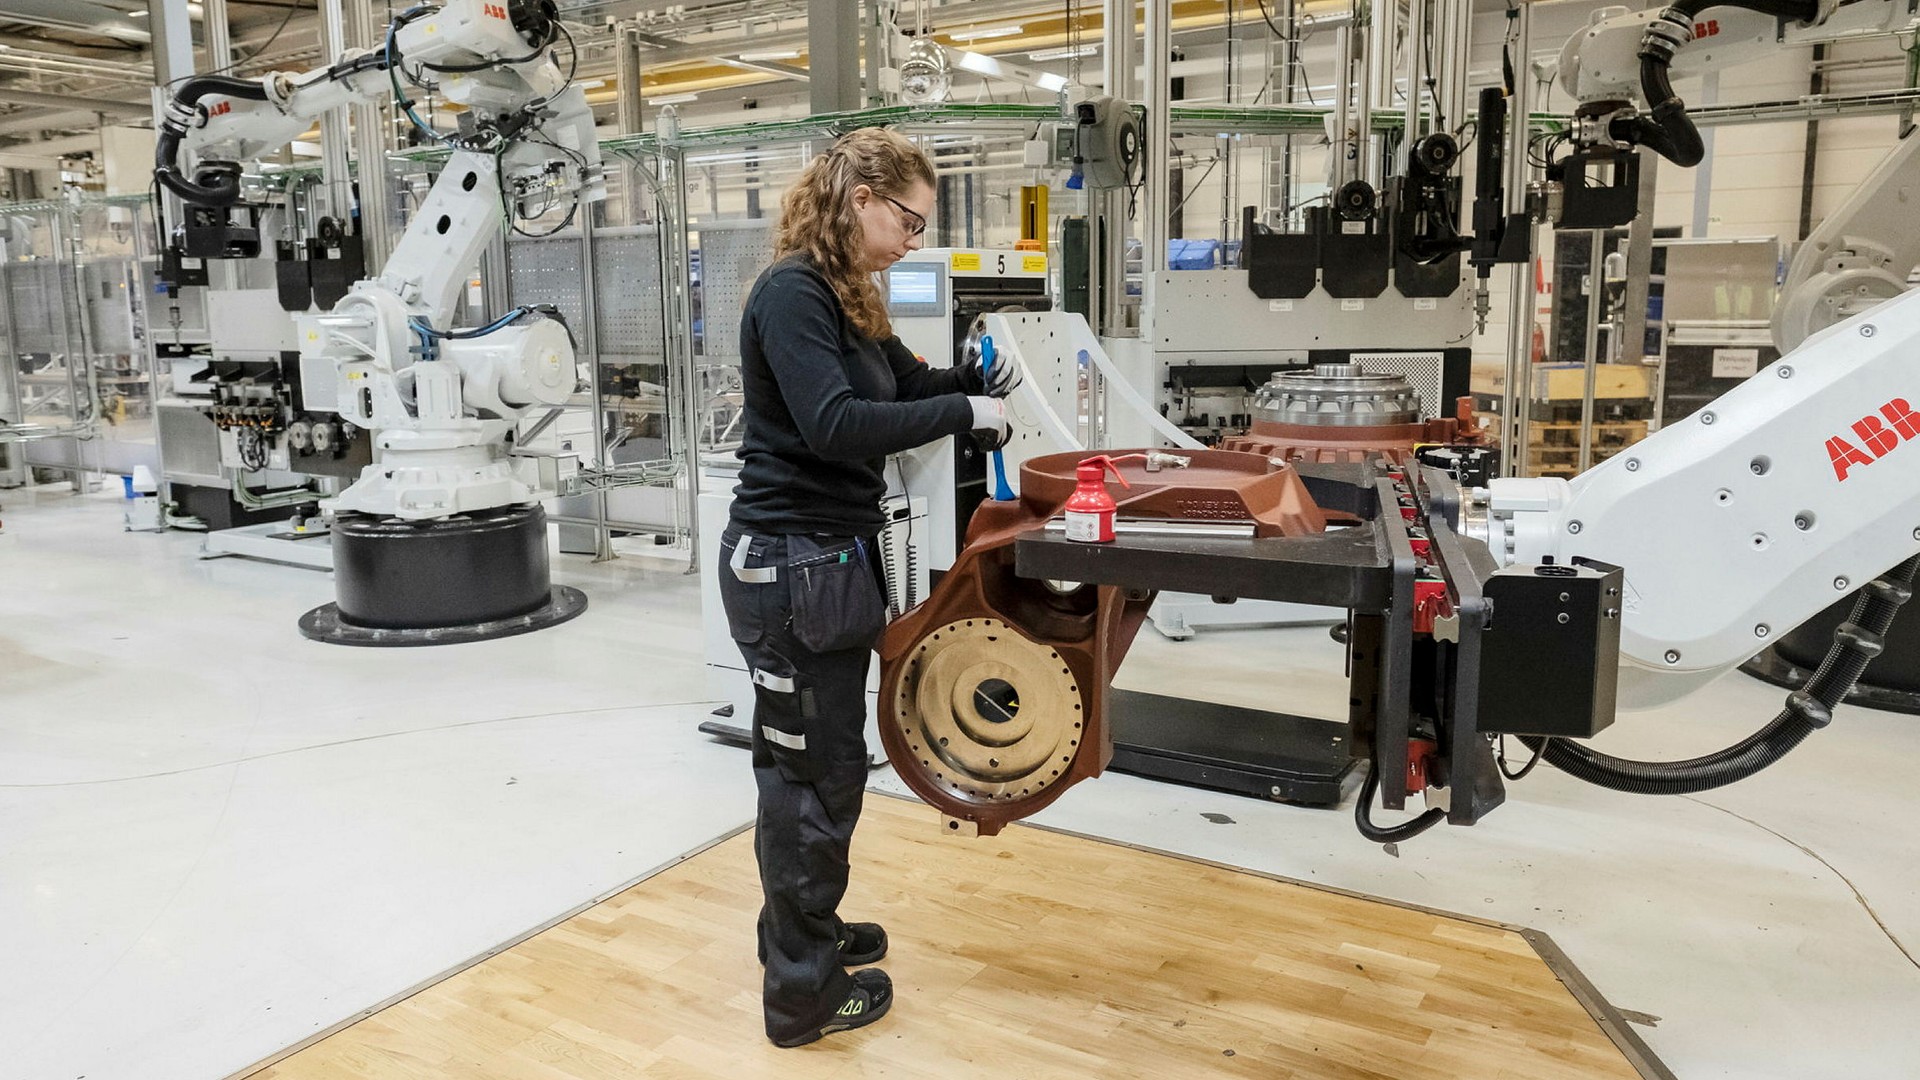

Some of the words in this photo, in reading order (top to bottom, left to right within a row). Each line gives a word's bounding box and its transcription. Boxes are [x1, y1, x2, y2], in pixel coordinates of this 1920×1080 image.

[484, 3, 506, 20] ABB
[1692, 20, 1719, 39] BB
[209, 101, 230, 118] ABB
[997, 254, 1005, 275] 5
[1825, 398, 1920, 482] ABB
